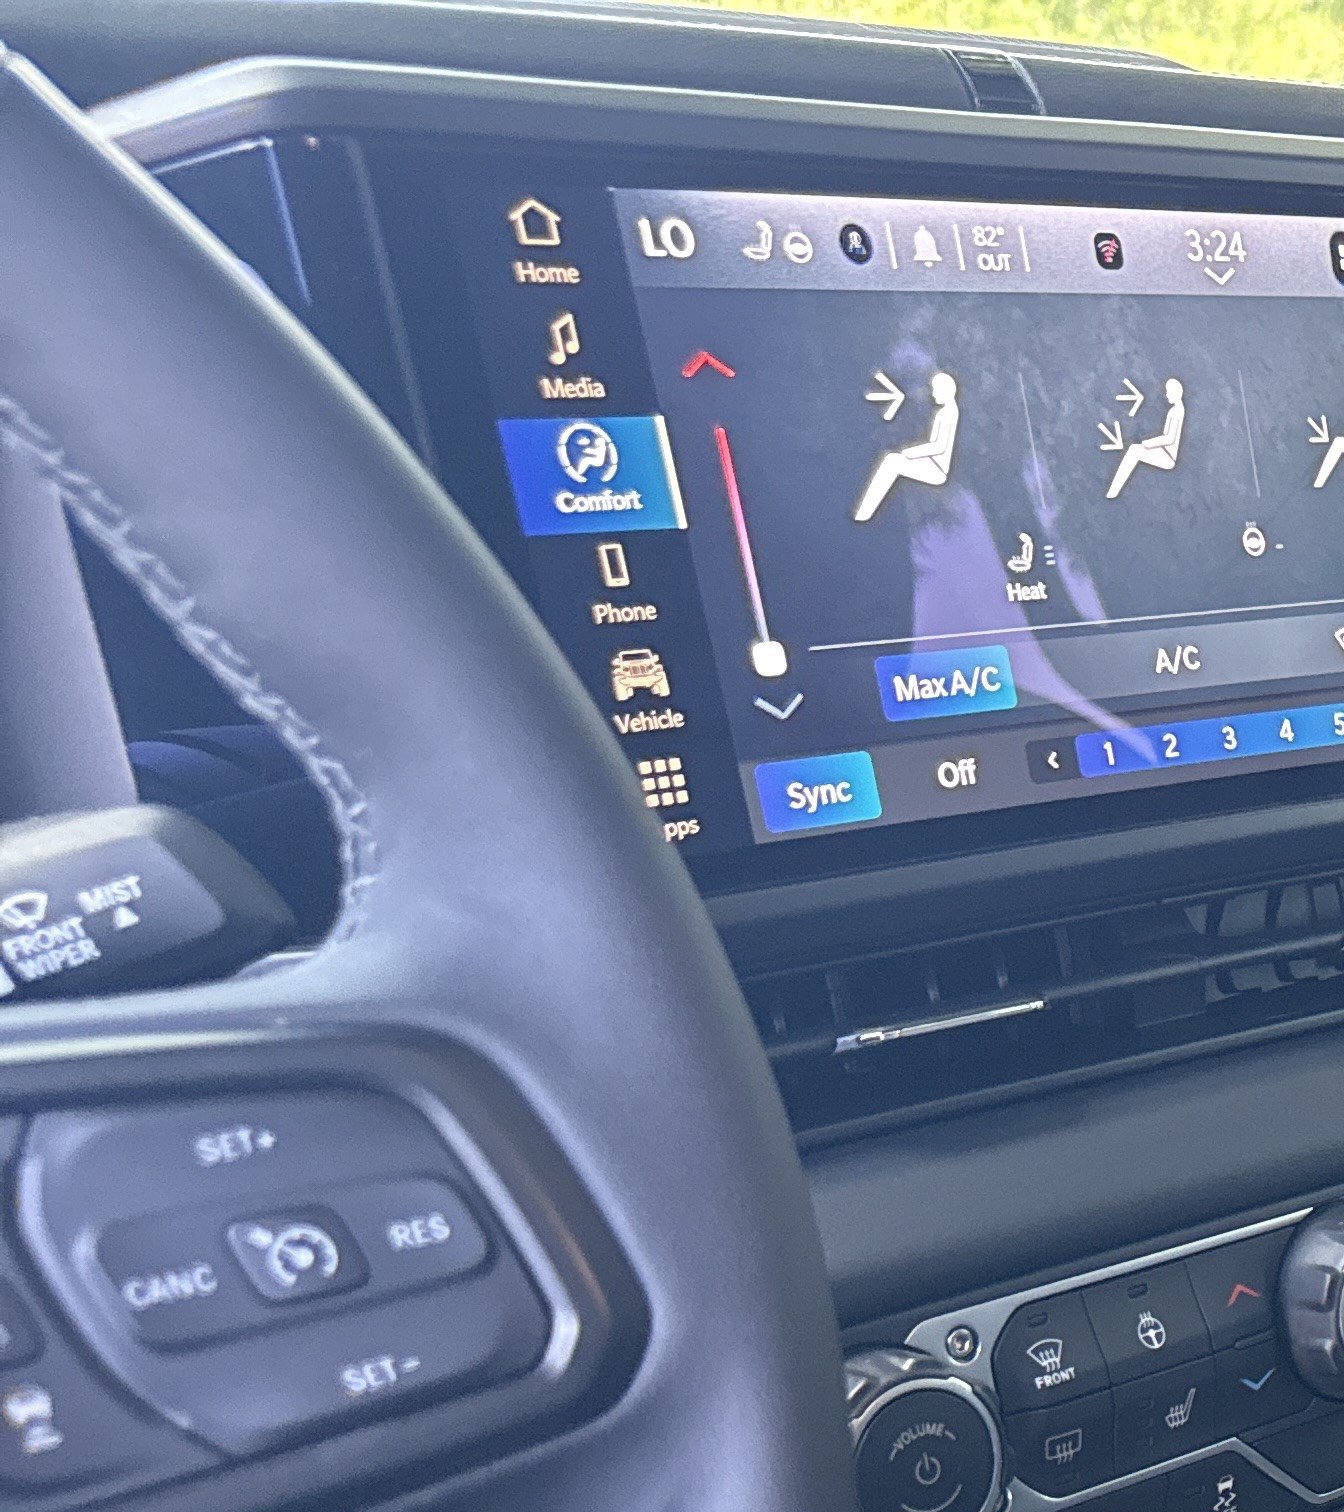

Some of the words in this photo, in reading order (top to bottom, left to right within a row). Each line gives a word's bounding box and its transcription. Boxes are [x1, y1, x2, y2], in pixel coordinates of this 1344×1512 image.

[638, 217, 696, 258] LO
[972, 224, 1005, 249] 82°
[1186, 229, 1247, 265] 3:24
[514, 260, 579, 284] Home
[977, 252, 1012, 272] OUT
[541, 376, 605, 400] Media
[556, 489, 643, 514] Comfort
[1006, 581, 1047, 602] Heat
[593, 600, 657, 623] Phone
[1154, 645, 1201, 675] A/C
[893, 673, 951, 703] Max
[949, 664, 1001, 698] A/C
[614, 710, 685, 734] Vehicle
[1103, 742, 1116, 766] 1
[1161, 734, 1180, 759] 2
[1222, 726, 1239, 751] 3
[1279, 718, 1295, 742] 4
[937, 758, 977, 789] Off
[787, 778, 853, 813] Sync
[664, 818, 700, 841] pps
[77, 875, 142, 914] MIST
[2, 916, 85, 961] FRONT
[14, 938, 100, 981] WIPER
[389, 1212, 451, 1251] RES
[121, 1264, 218, 1310] CANC
[1034, 1366, 1077, 1391] FRONT
[893, 1422, 945, 1453] VOLUME
